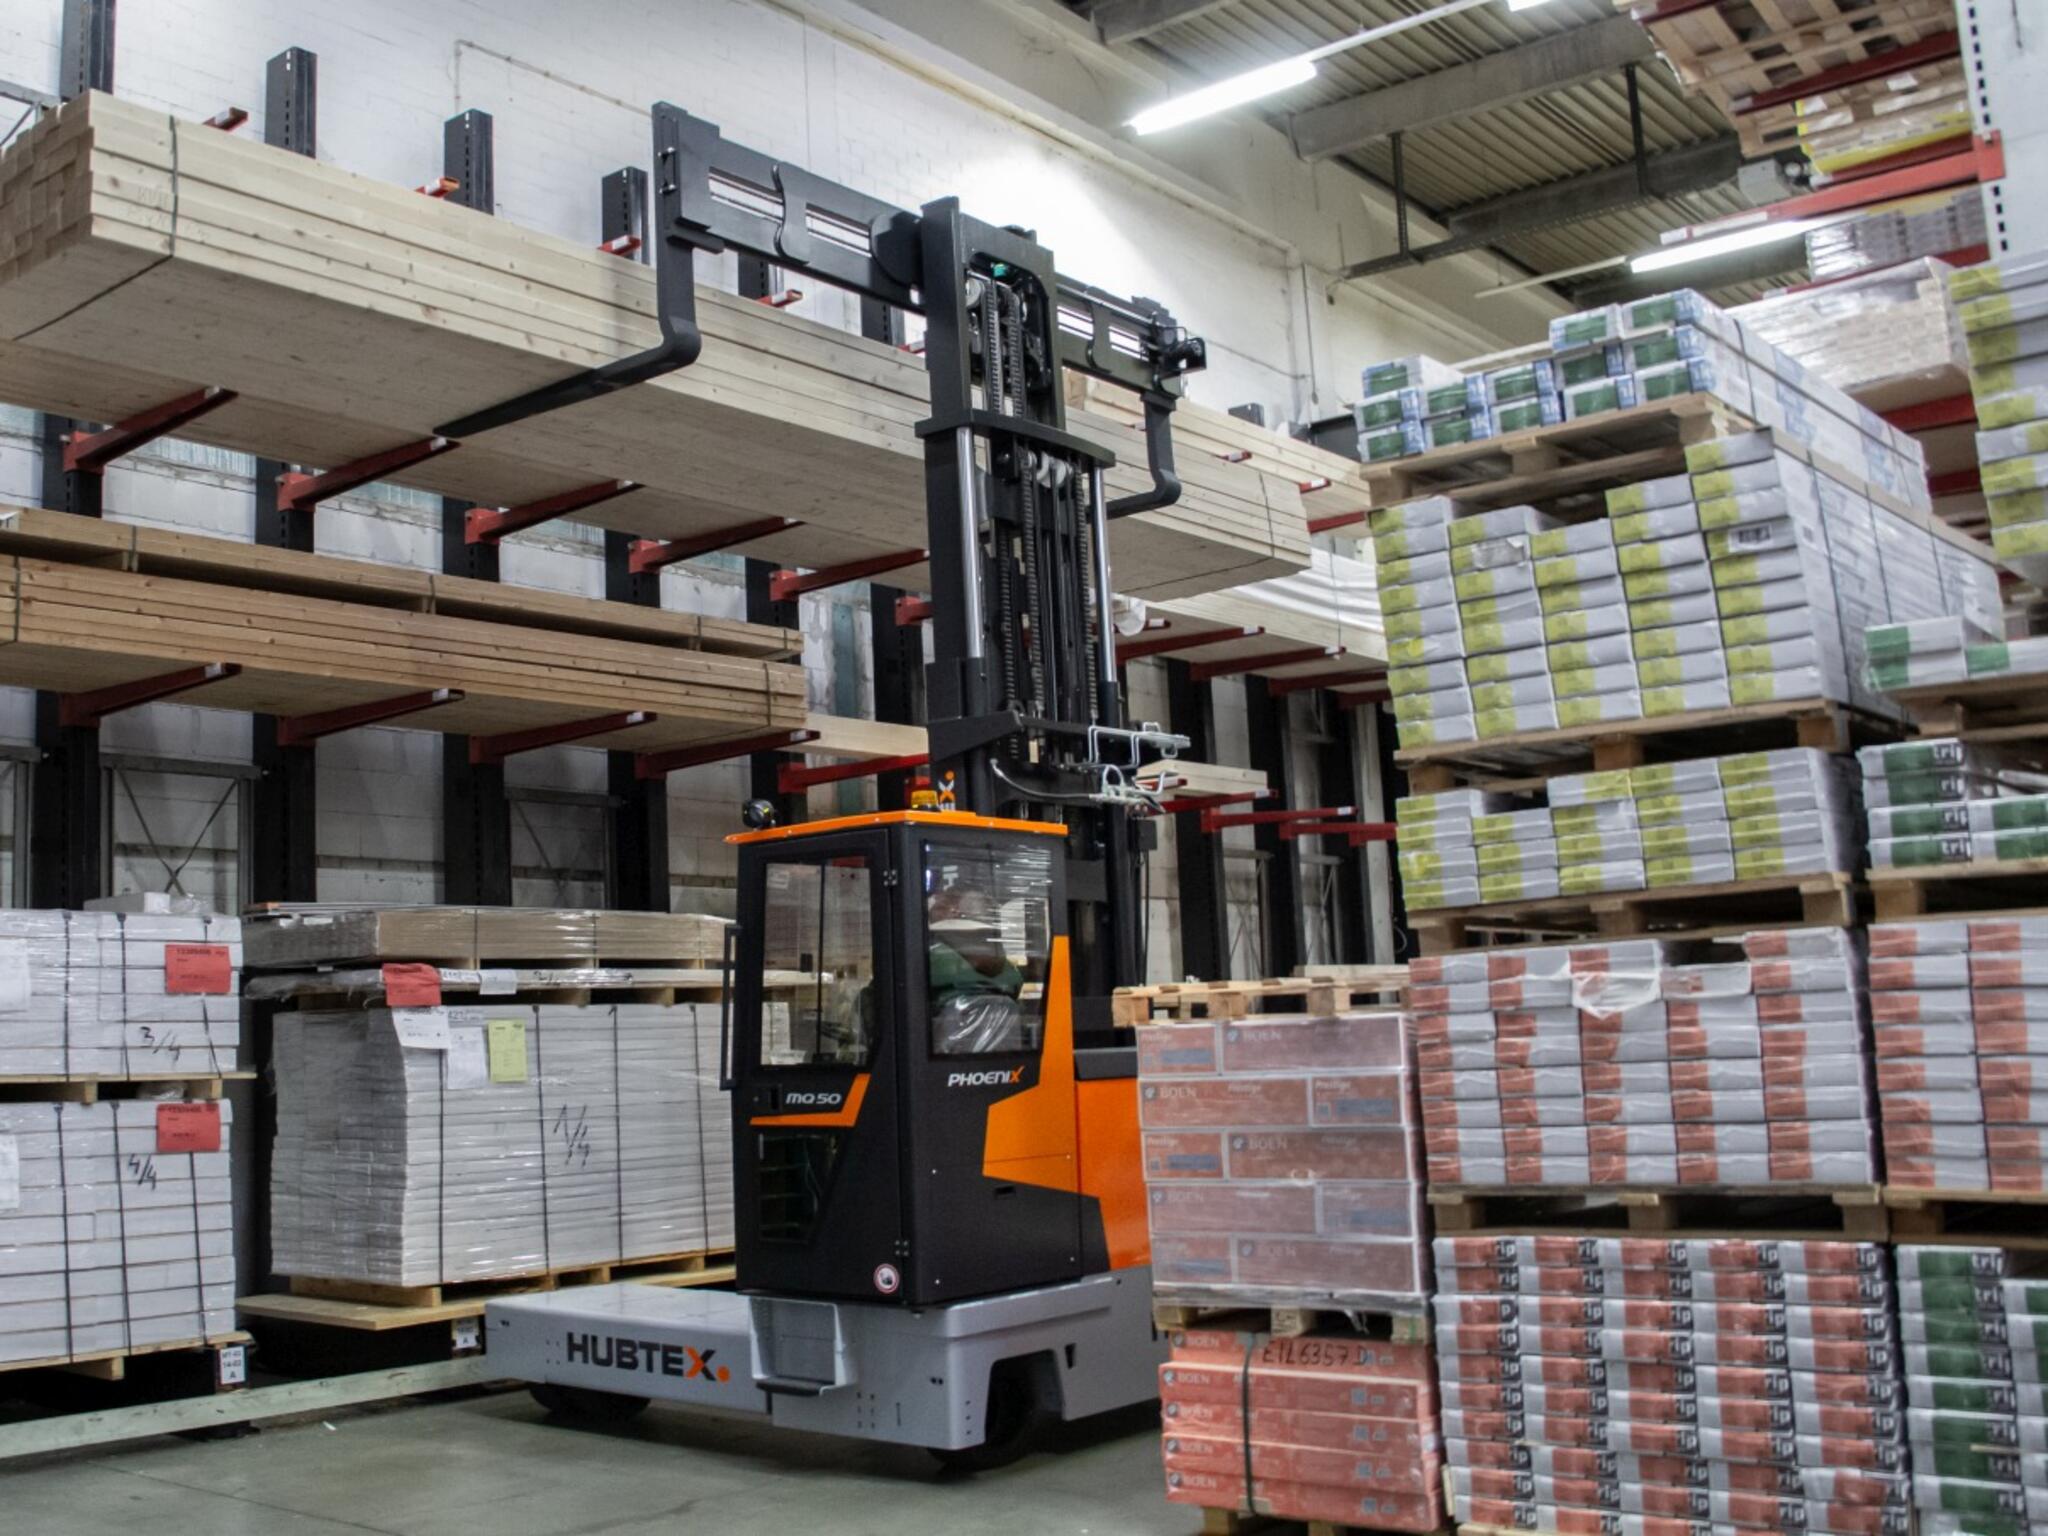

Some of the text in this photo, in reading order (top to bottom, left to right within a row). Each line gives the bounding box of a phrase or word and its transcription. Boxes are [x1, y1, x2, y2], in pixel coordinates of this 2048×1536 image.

[948, 1065, 1025, 1087] PHOENIX
[816, 1092, 842, 1104] 50
[127, 1153, 158, 1191] 4/4
